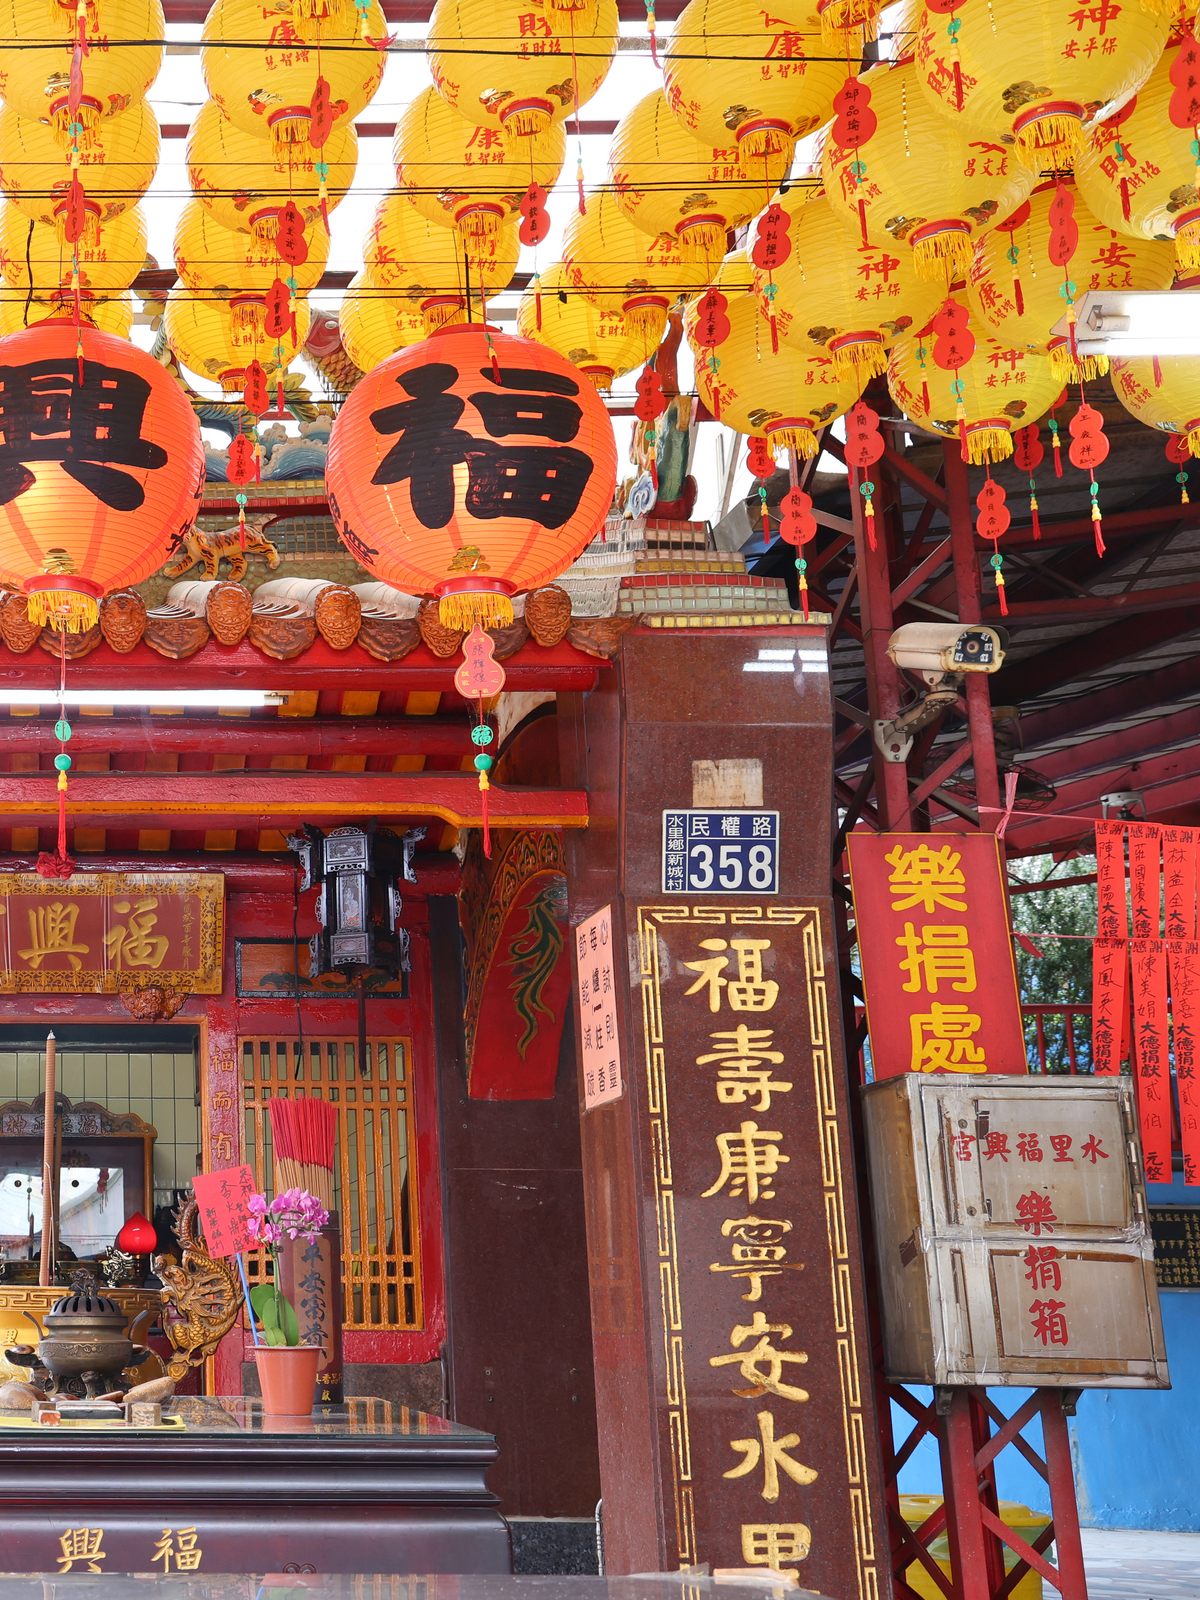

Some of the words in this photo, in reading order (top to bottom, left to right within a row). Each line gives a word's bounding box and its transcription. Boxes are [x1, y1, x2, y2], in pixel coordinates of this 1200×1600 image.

[667, 815, 684, 851] 水里鄉
[690, 816, 772, 837] 民權路
[1130, 825, 1159, 839] 感謝
[1164, 830, 1193, 843] 感謝
[666, 853, 684, 891] 新城村
[689, 844, 773, 891] 358
[885, 843, 987, 1074] 樂捐處
[1133, 940, 1162, 954] 感謝
[1169, 942, 1199, 955] 感謝
[1014, 1190, 1069, 1347] 樂捐箱
